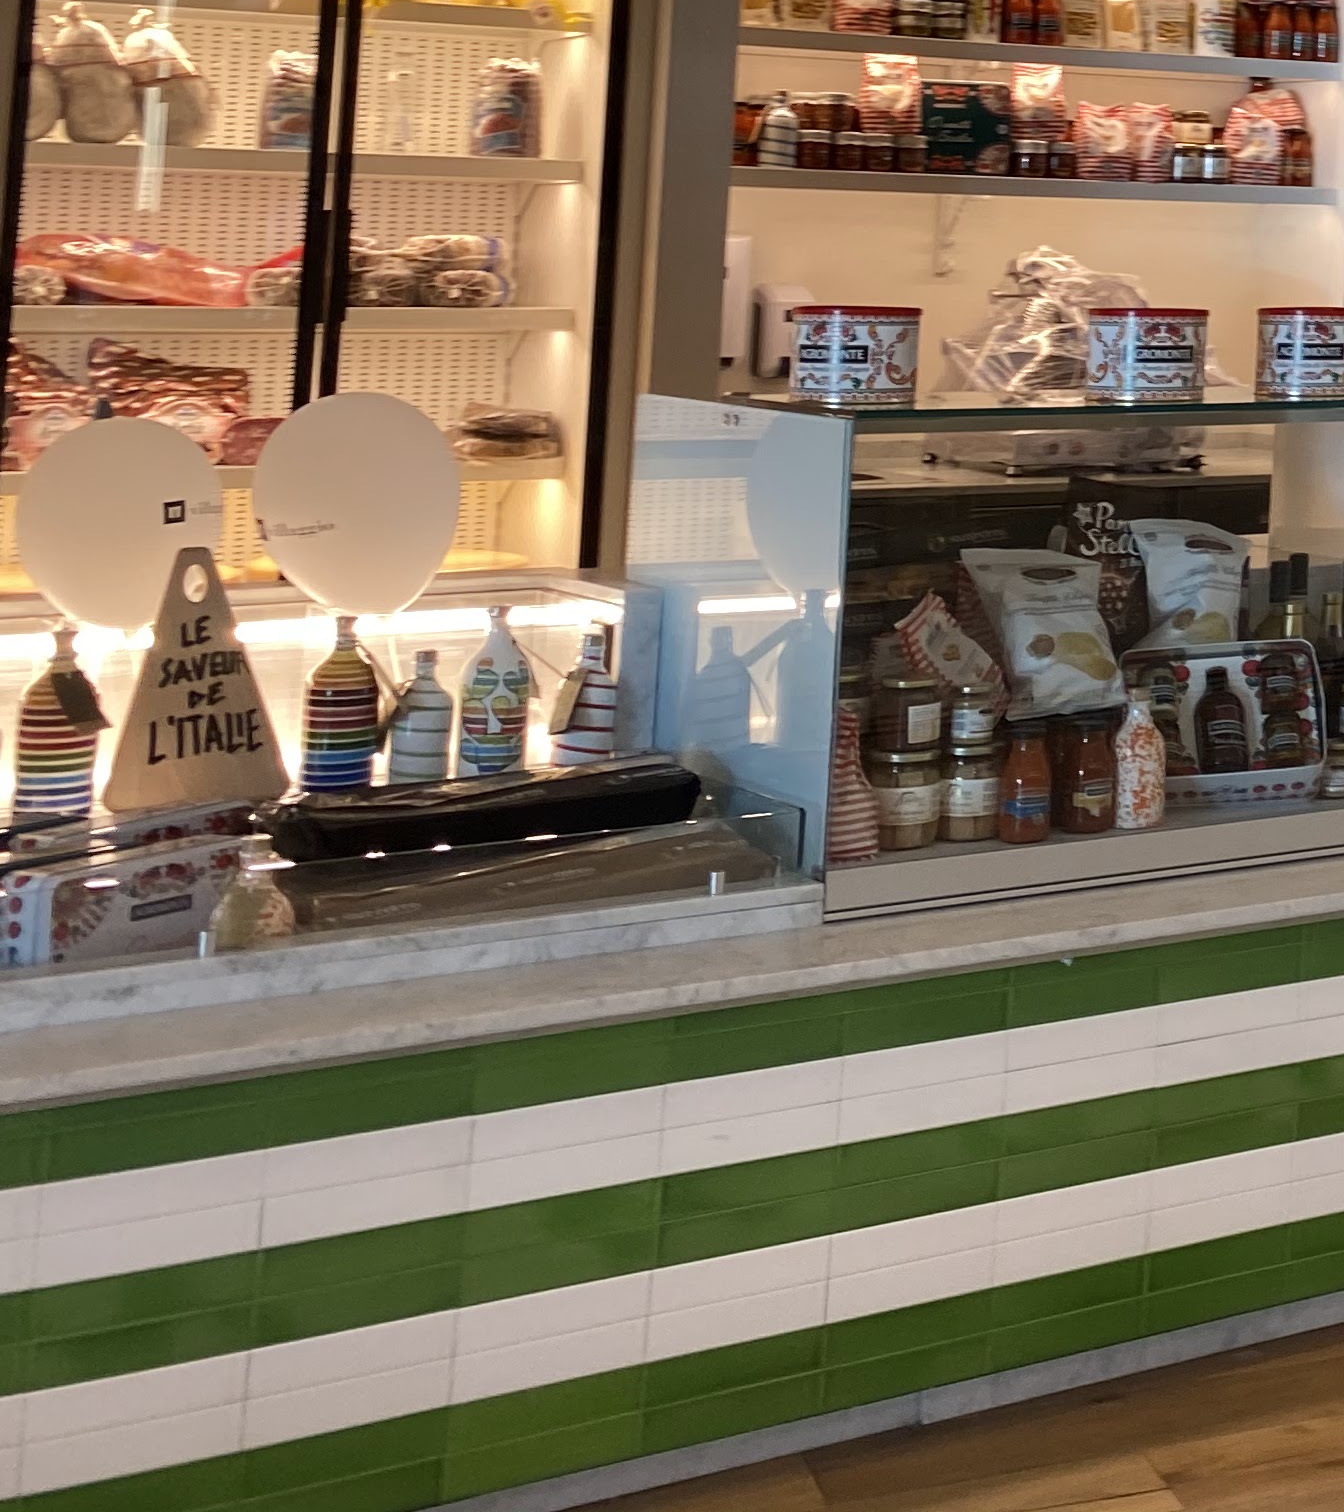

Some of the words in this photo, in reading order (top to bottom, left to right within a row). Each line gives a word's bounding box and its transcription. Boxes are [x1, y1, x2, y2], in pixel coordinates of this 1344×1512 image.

[180, 615, 212, 648] LE
[187, 681, 226, 709] DE
[148, 708, 263, 766] L'ITALIE
